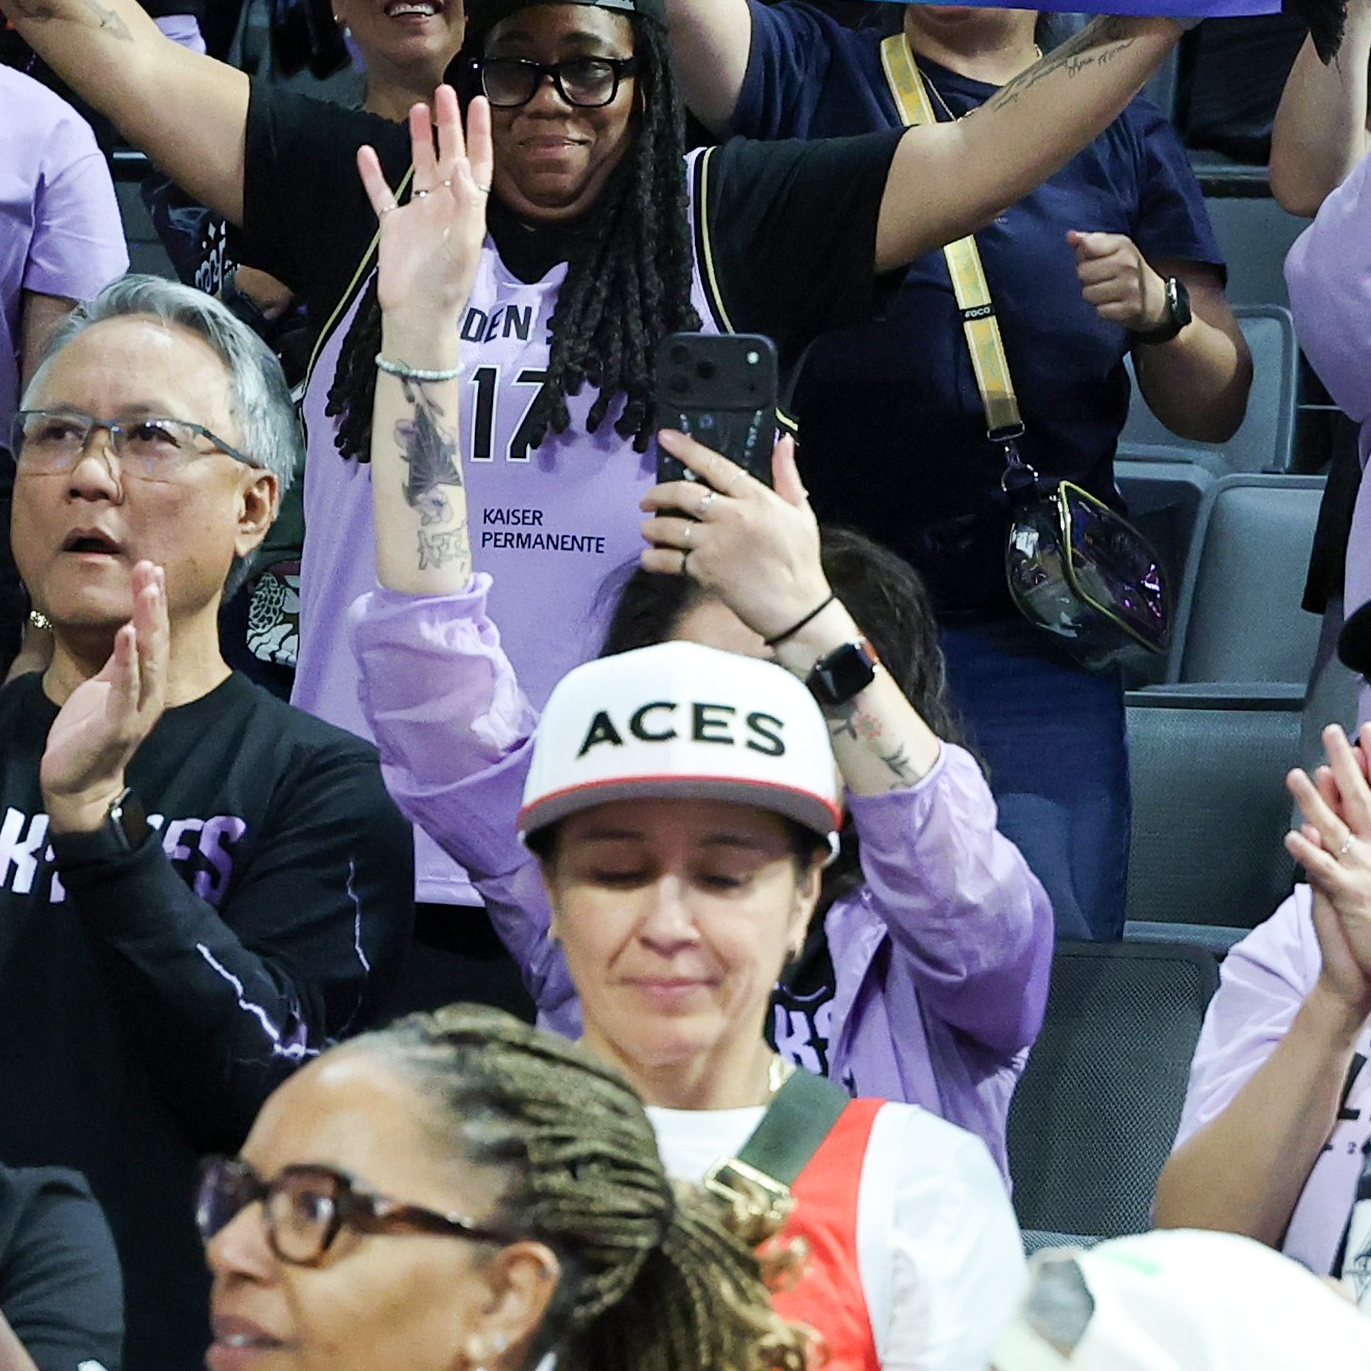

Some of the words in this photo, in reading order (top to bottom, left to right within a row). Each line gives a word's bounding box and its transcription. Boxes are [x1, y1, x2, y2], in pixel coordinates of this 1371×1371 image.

[460, 304, 533, 345] DEN
[468, 364, 549, 463] 17
[483, 508, 544, 527] KAISER
[482, 532, 606, 554] PERMANENTE
[576, 701, 786, 760] ACES
